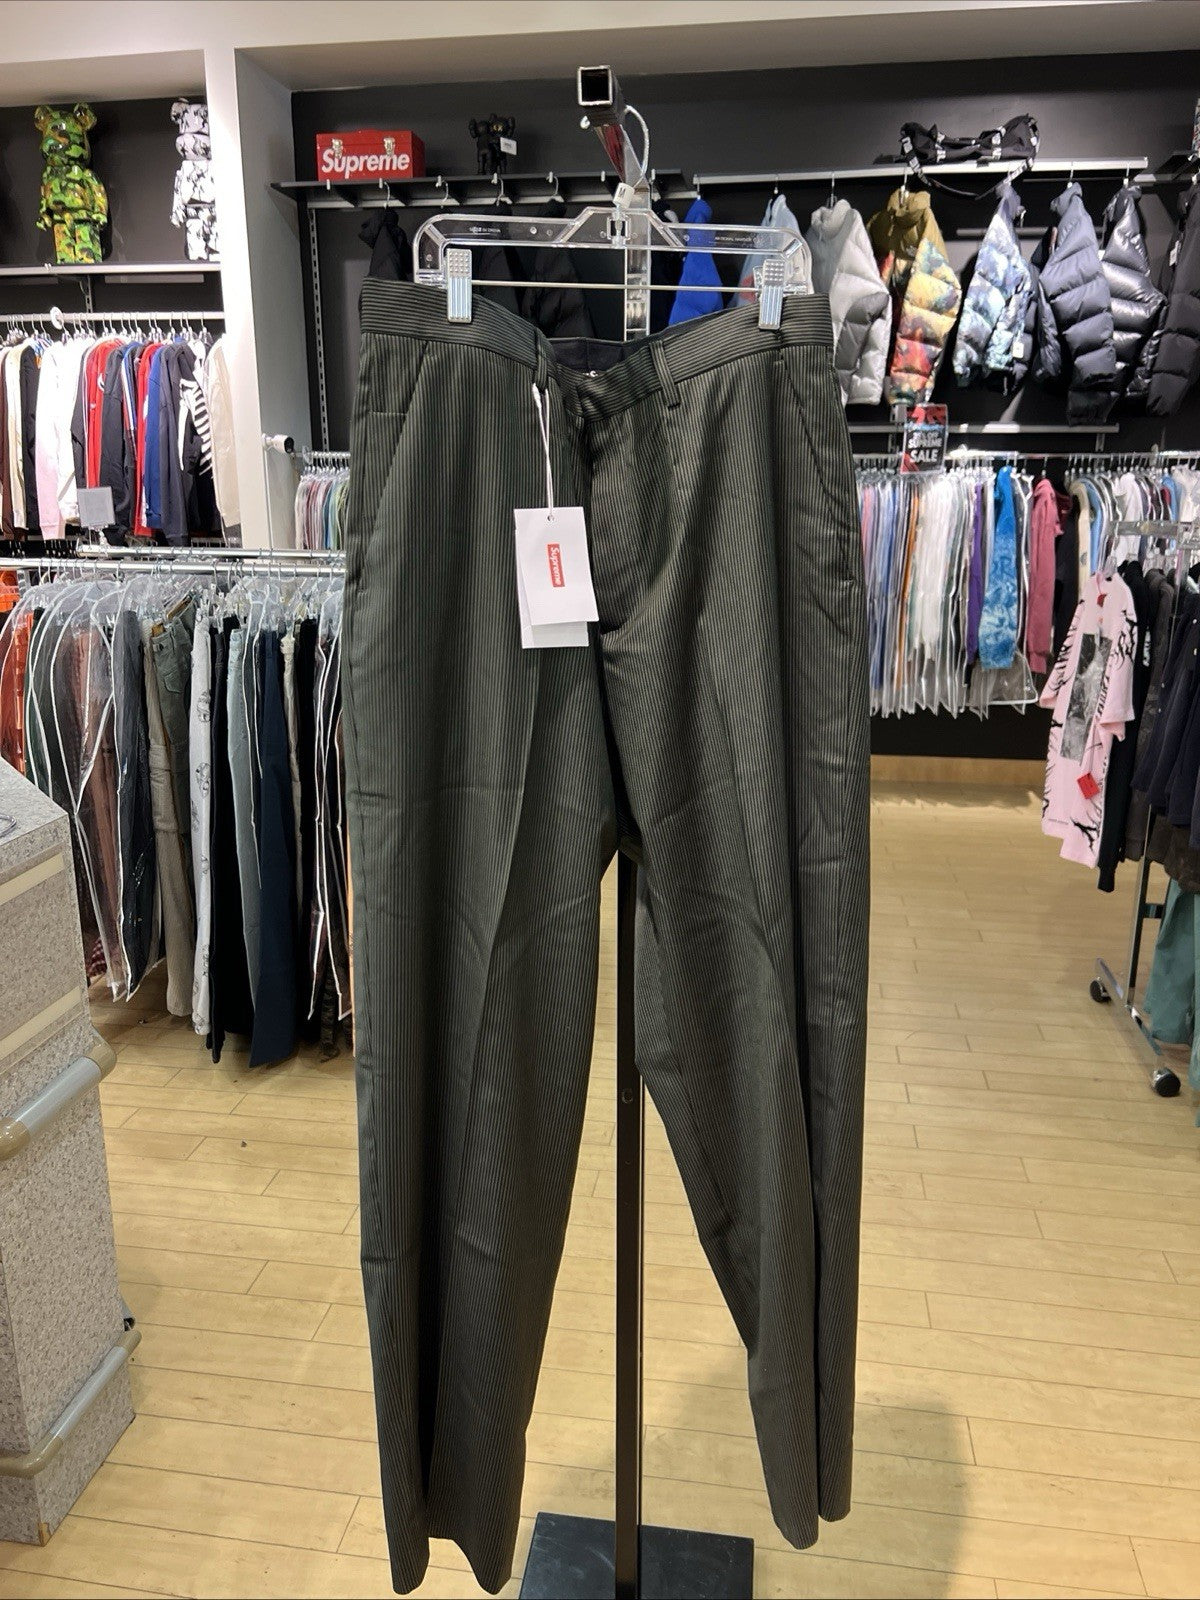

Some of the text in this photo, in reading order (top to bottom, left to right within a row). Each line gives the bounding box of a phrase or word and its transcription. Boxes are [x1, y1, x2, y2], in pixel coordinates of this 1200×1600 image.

[321, 148, 410, 179] Supreme
[909, 449, 939, 463] SALE
[549, 546, 562, 586] Supreme
